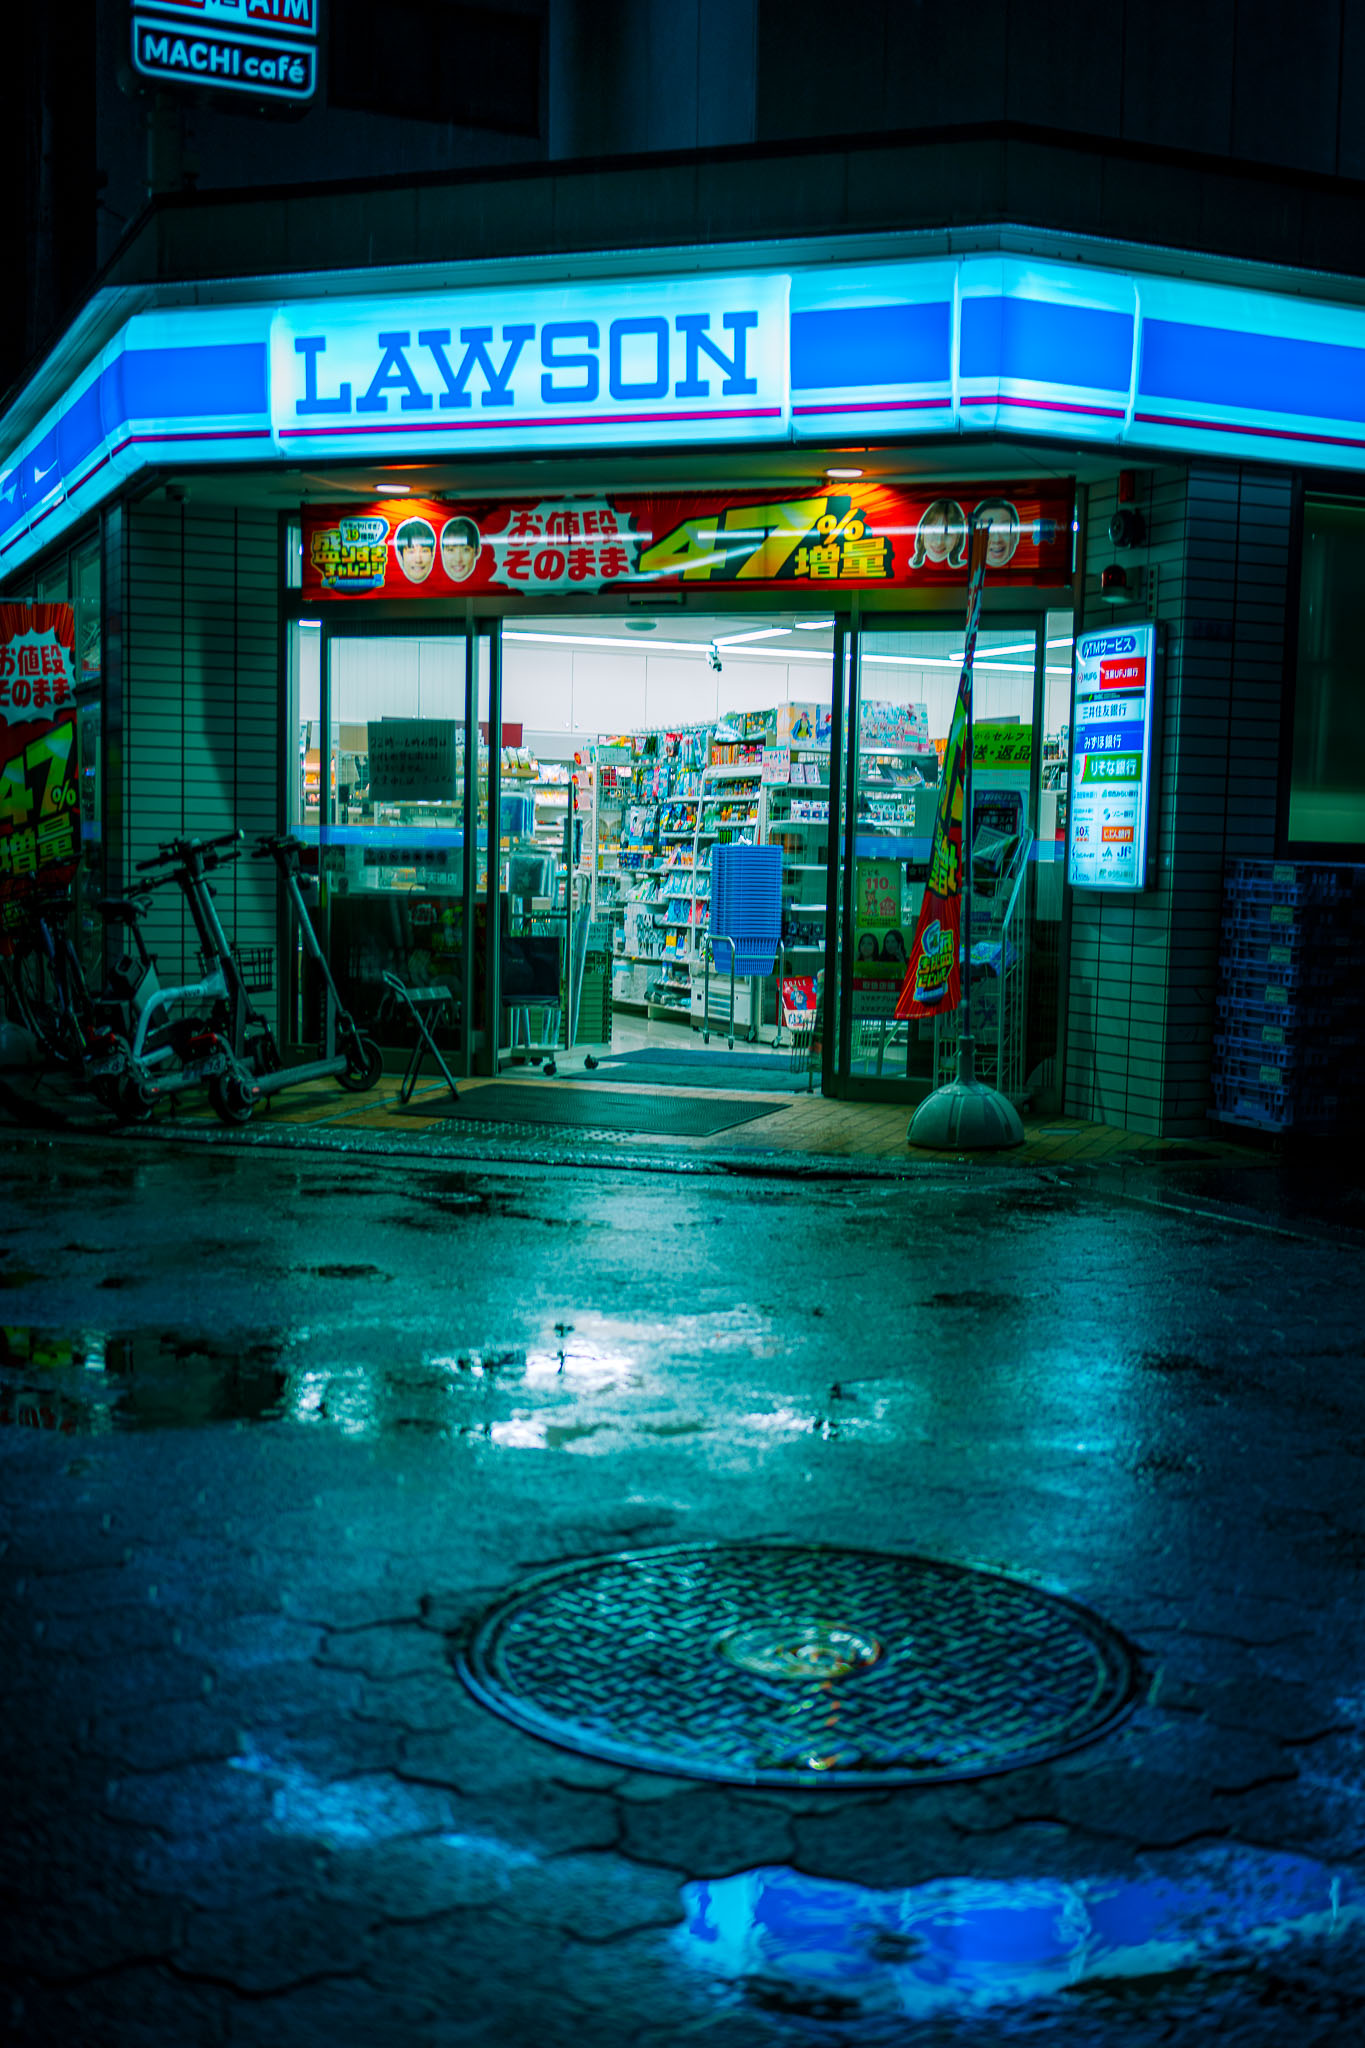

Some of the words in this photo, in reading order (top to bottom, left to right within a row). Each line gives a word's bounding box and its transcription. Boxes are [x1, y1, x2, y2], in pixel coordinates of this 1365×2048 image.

[144, 34, 239, 75] MACHI
[244, 55, 304, 84] café
[295, 311, 758, 415] LAWSON
[507, 510, 624, 547] お値段
[501, 549, 630, 583] そのまま
[794, 536, 888, 579] 増量
[0, 645, 66, 677] お値段
[1083, 703, 1127, 719] 三井住友銀行
[1083, 734, 1122, 750] みずほ銀行
[1090, 758, 1137, 776] りそな銀行
[866, 877, 889, 890] 110
